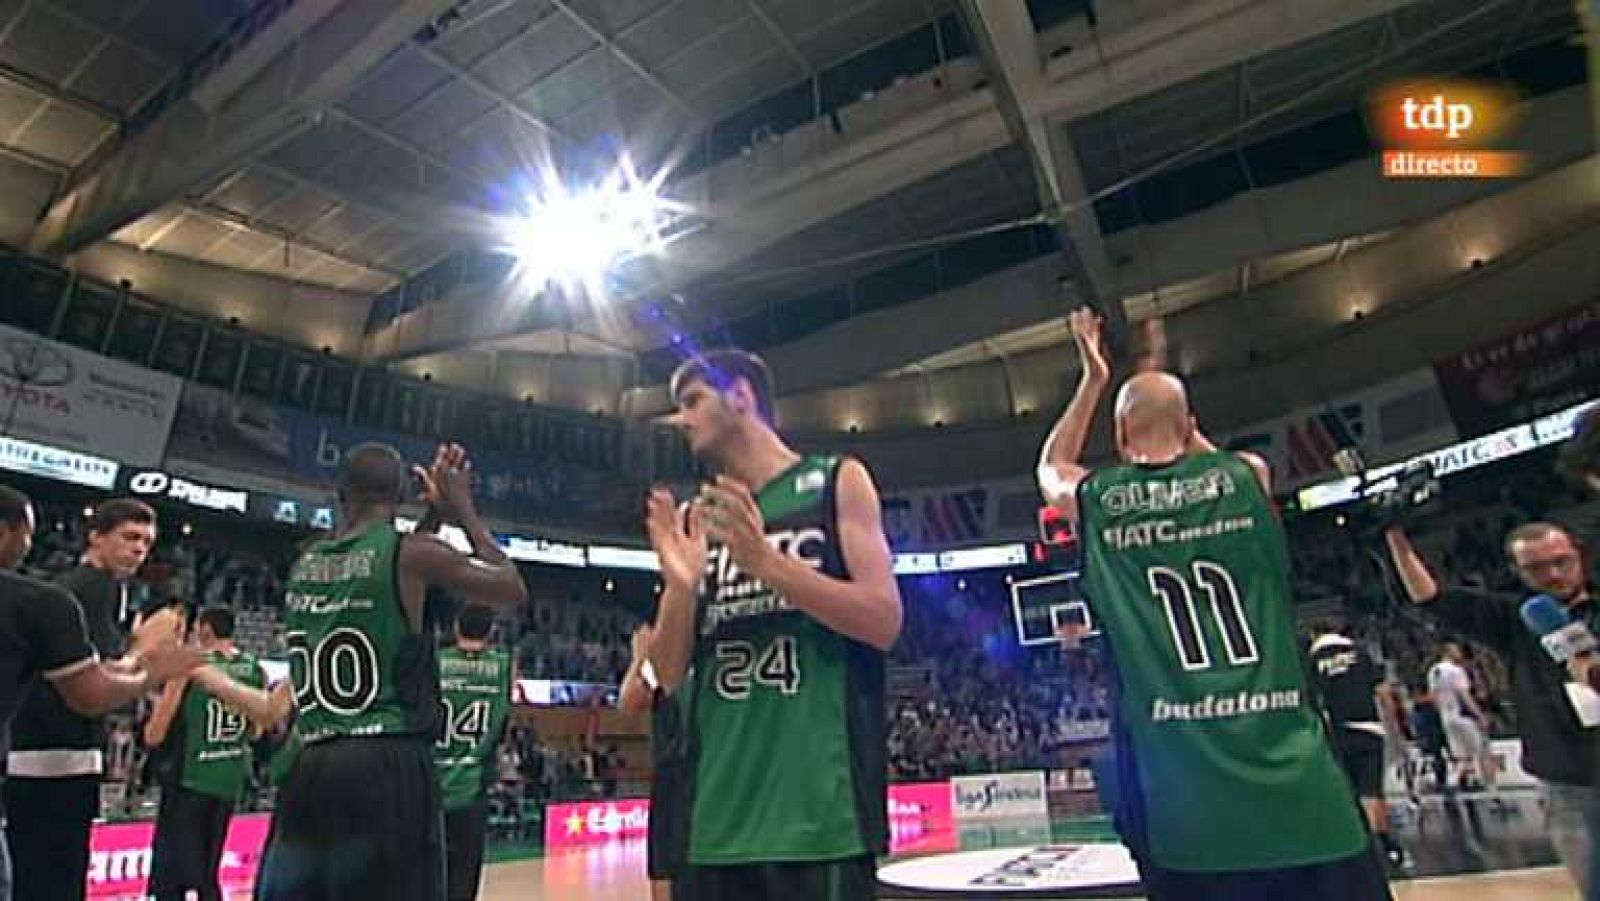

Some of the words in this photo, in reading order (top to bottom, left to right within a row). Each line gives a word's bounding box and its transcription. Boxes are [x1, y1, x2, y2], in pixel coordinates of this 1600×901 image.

[699, 530, 825, 594] FITC
[1147, 560, 1260, 670] 11
[715, 637, 800, 700] 24
